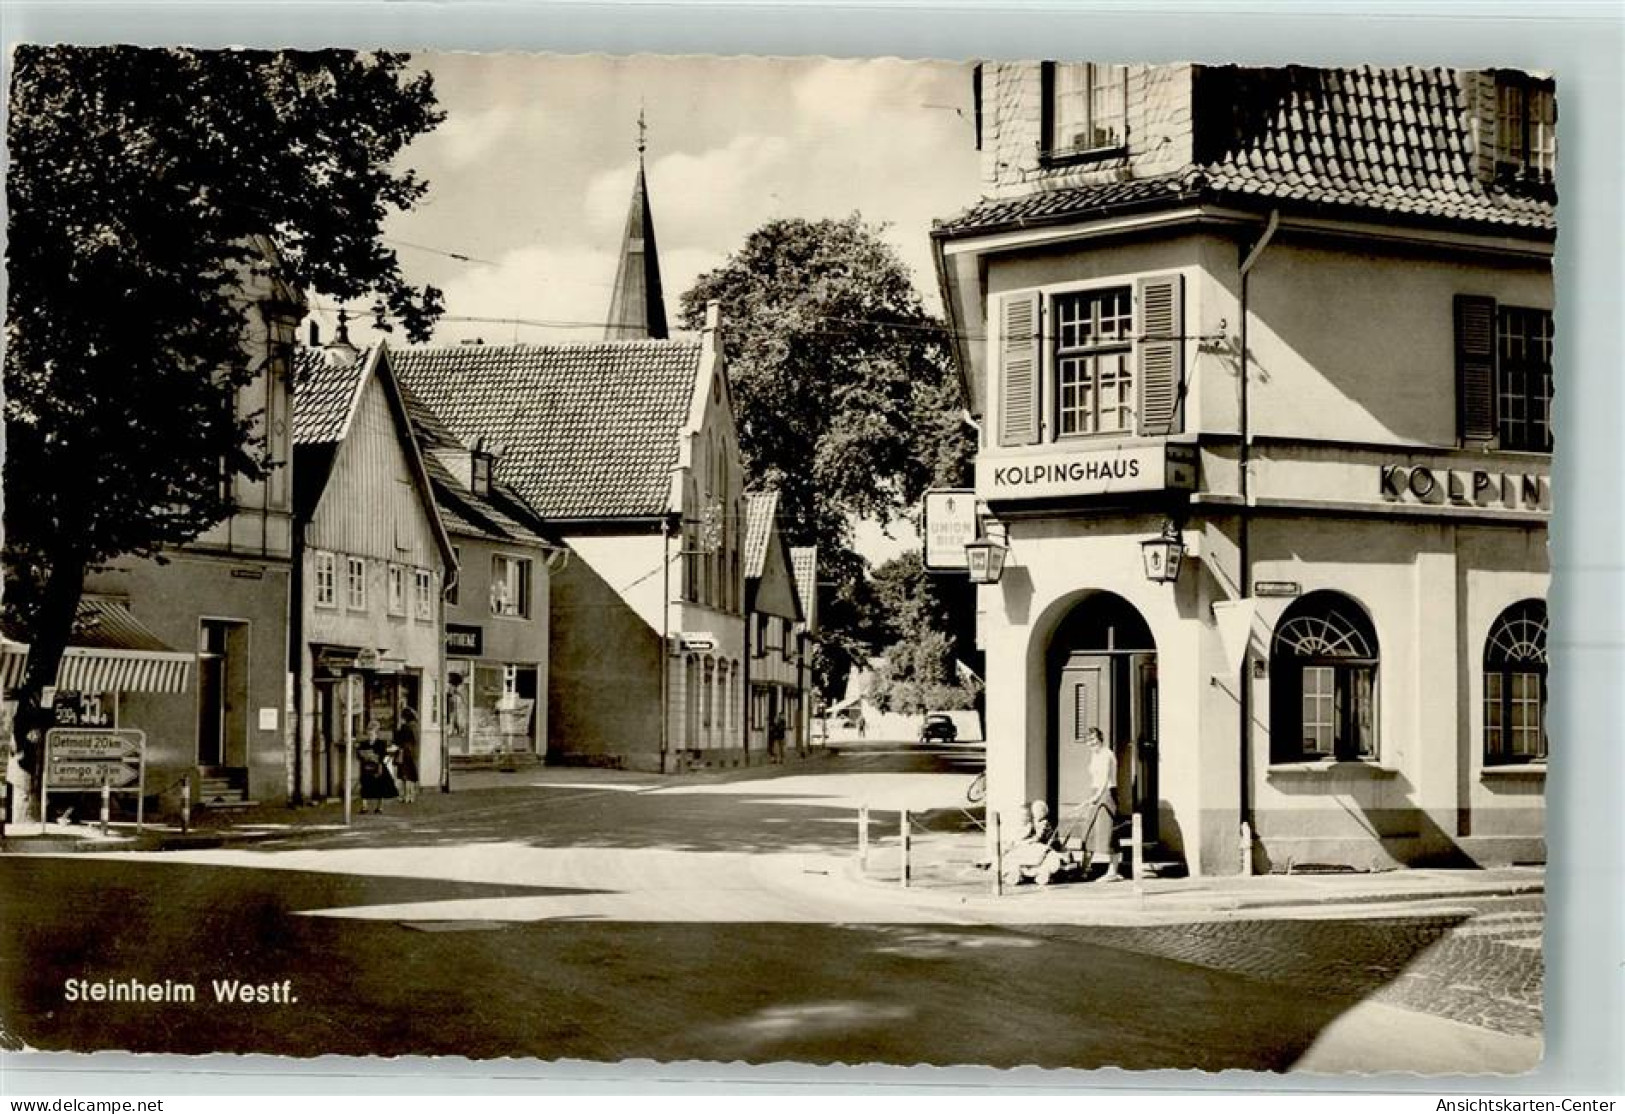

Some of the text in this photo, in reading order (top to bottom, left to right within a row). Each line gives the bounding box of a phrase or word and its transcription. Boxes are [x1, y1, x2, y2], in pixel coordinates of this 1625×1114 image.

[994, 459, 1140, 485] KOLPINGHAUS
[1380, 465, 1541, 504] KOLPIN
[931, 521, 972, 534] UNION
[53, 735, 92, 748] Detmold
[54, 765, 92, 778] Lemgo
